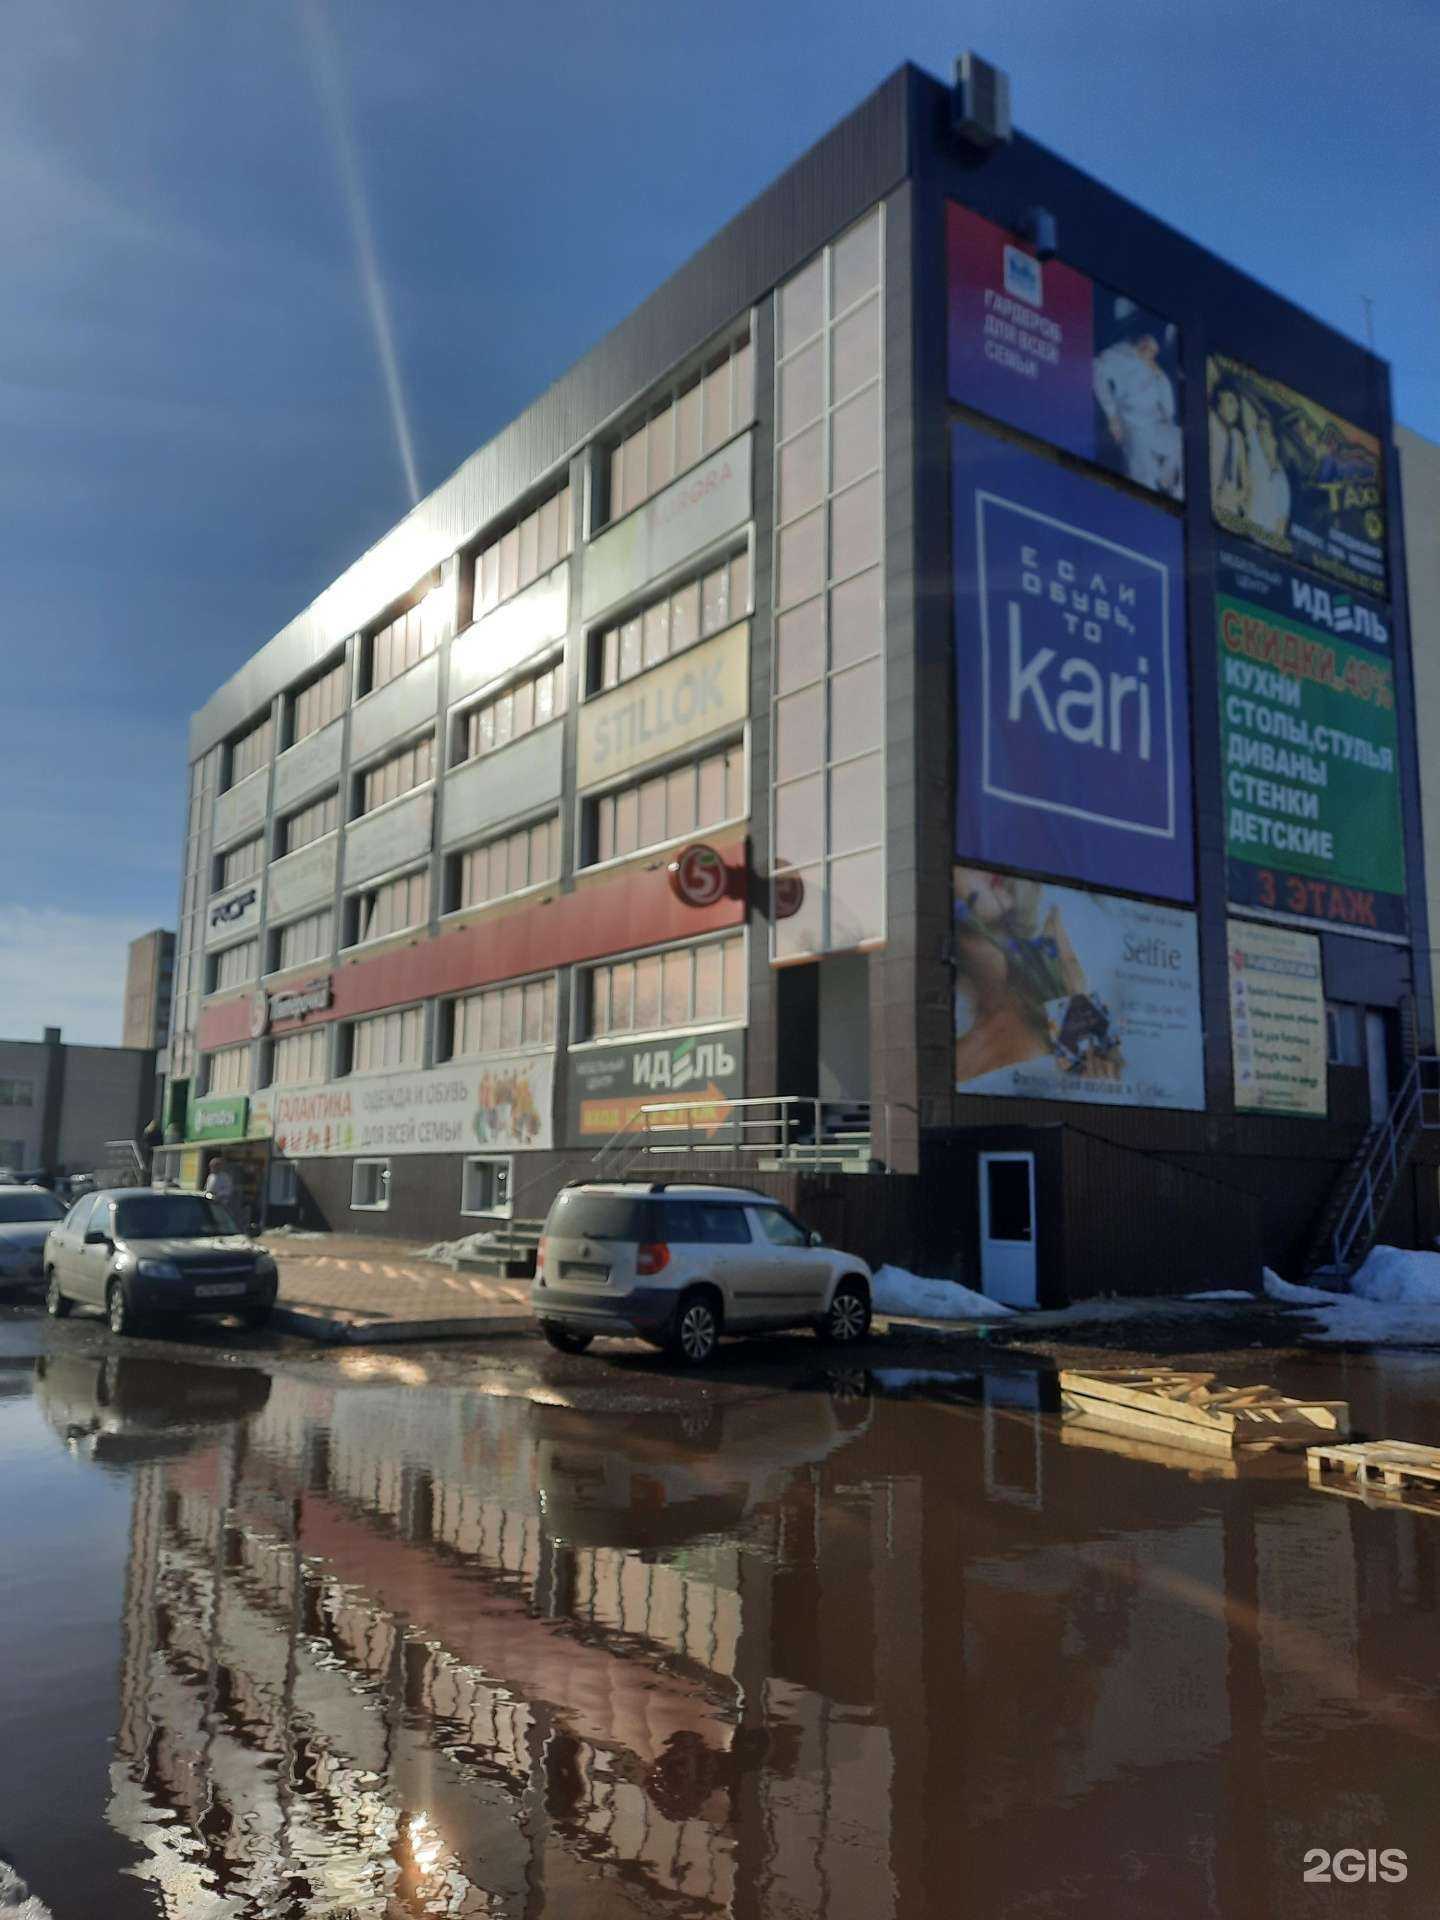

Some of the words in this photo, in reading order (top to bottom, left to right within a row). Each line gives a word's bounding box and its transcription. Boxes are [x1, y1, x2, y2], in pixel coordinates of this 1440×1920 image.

[1008, 600, 1150, 761] kari
[1225, 656, 1300, 708] КУХНИ
[1228, 732, 1328, 787] ДИВАНЫ
[1228, 771, 1319, 820] СТЕНКИ
[1230, 807, 1335, 860] ДЕТСКИЕ
[1287, 876, 1377, 929] ЭТАЖ
[1122, 934, 1182, 971] Selfie
